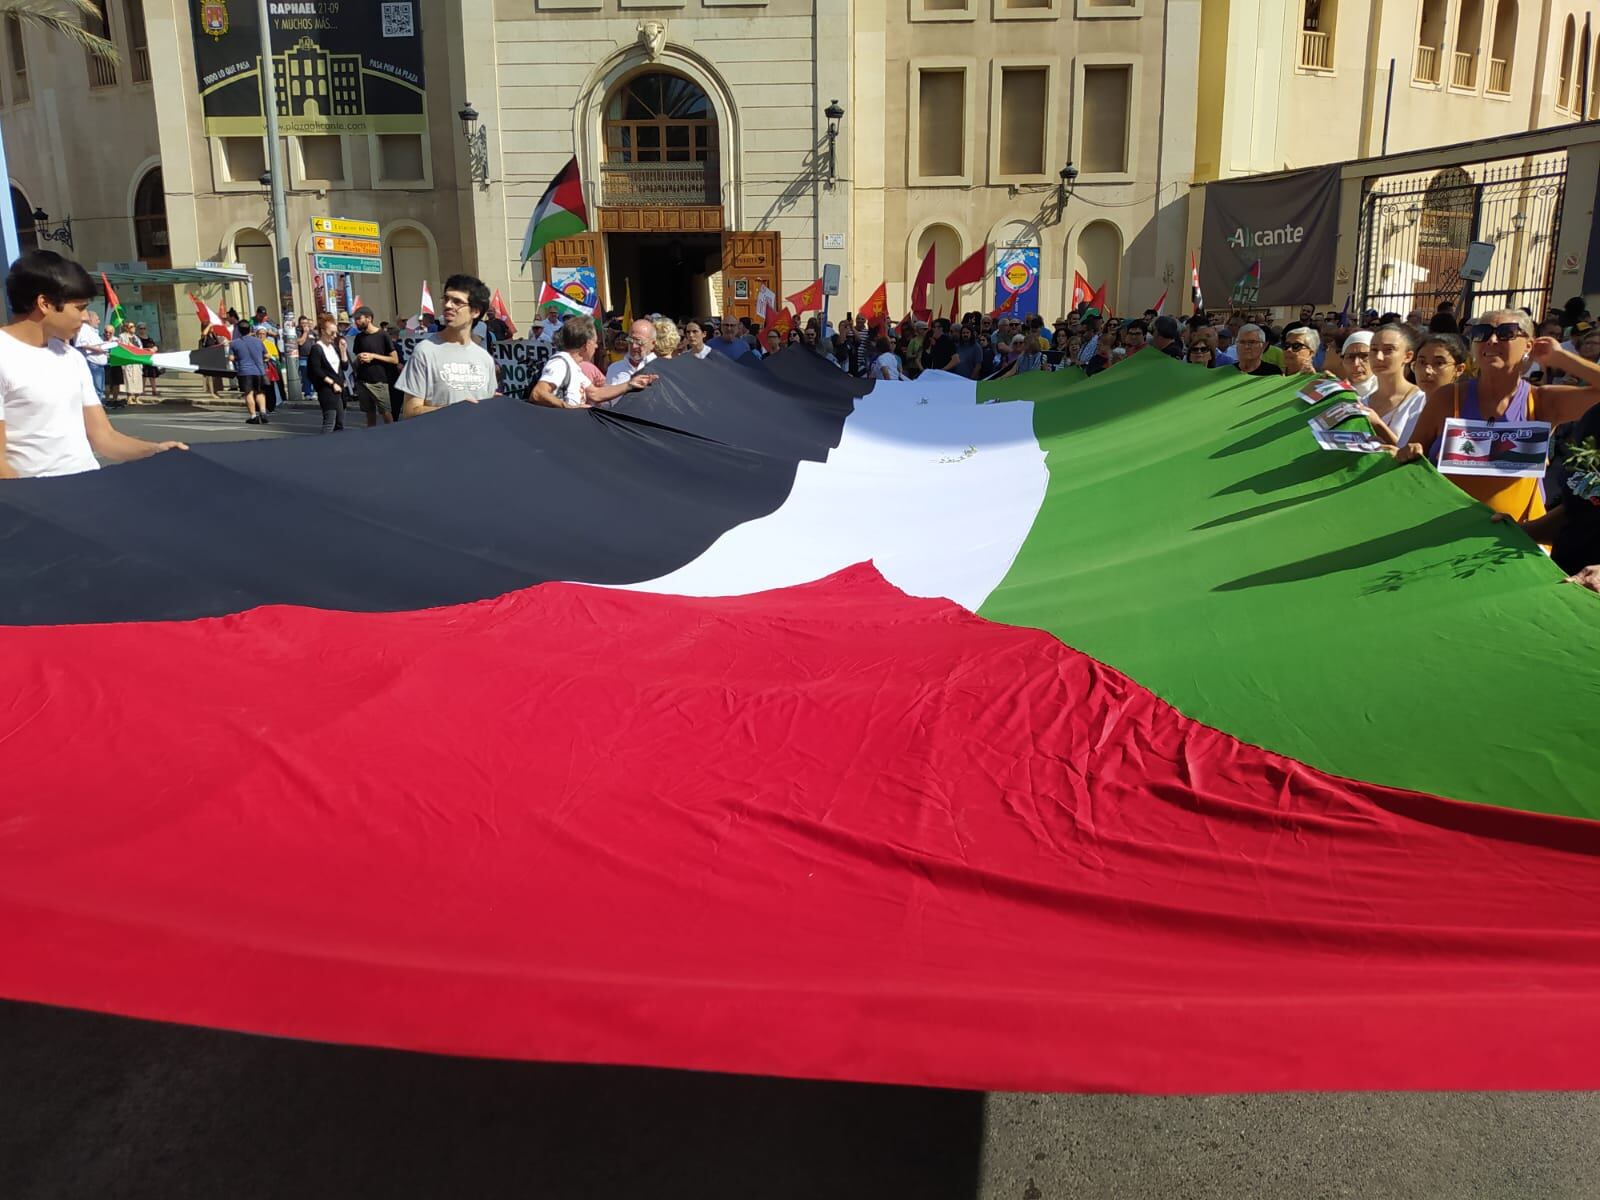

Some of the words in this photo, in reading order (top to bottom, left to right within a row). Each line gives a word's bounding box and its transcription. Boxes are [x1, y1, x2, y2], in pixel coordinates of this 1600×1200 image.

[269, 2, 316, 14] RAPHAEL
[318, 2, 339, 14] 21-09
[273, 18, 280, 30] Y
[281, 18, 313, 30] MUCHOS
[203, 72, 219, 85] TODO
[217, 69, 226, 78] LO
[224, 65, 237, 75] QUE
[236, 61, 250, 71] PASA
[369, 58, 383, 69] PASA
[394, 67, 402, 75] LA
[402, 70, 418, 82] PLAZA
[1227, 223, 1304, 248] Alicante
[758, 256, 765, 265] 9
